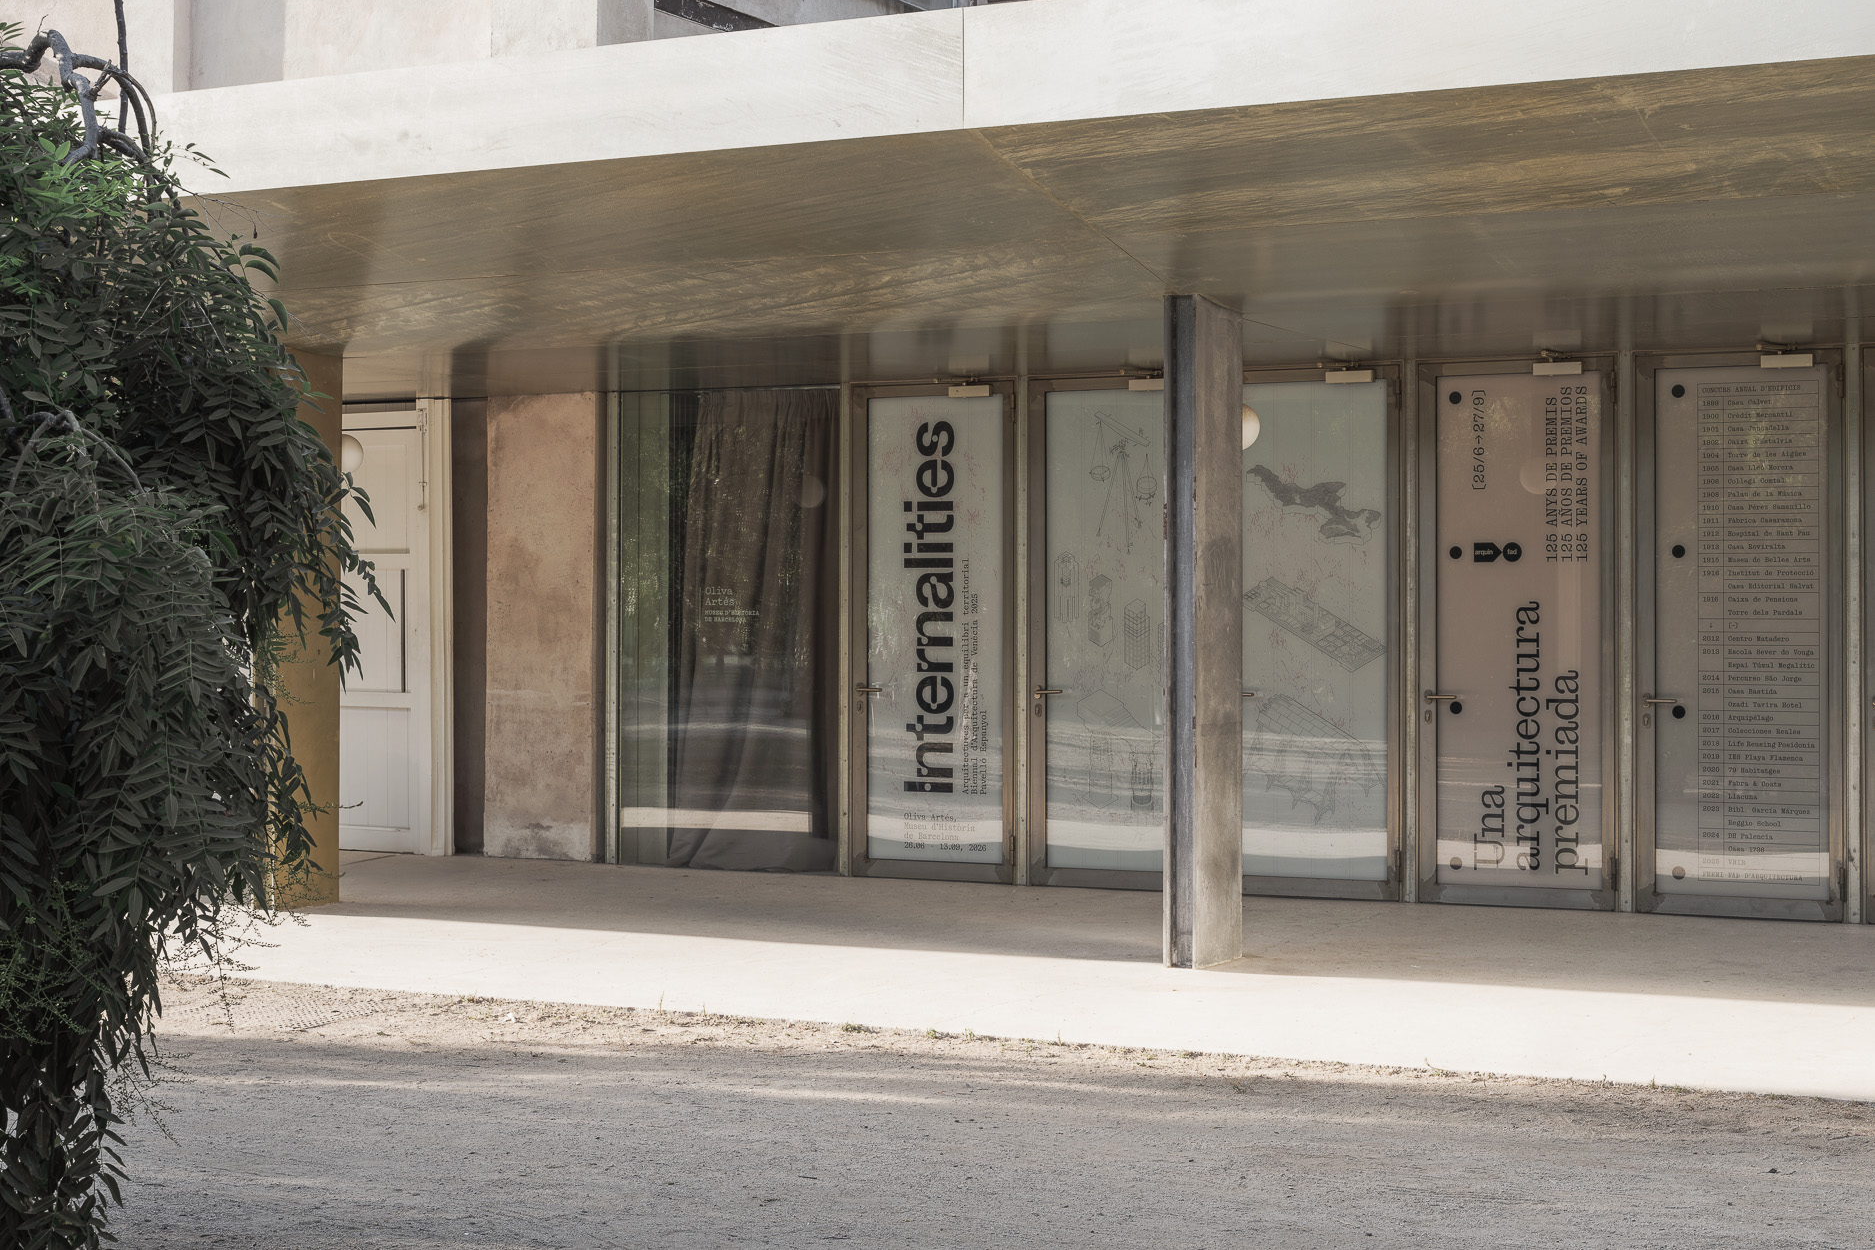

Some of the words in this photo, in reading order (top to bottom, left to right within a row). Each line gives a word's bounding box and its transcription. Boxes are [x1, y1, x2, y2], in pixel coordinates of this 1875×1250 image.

[1546, 396, 1558, 456] PREMIS
[1560, 386, 1573, 457] PREMIOS
[1576, 385, 1588, 446] AWARDS
[1546, 462, 1558, 482] DE
[1560, 462, 1573, 482] DE
[1576, 450, 1588, 472] OF
[1546, 488, 1558, 528] ANYS
[1558, 488, 1573, 528] AÑOS
[1576, 477, 1588, 528] YEARS
[1546, 533, 1558, 563] 125
[1560, 533, 1573, 563] 125
[1576, 533, 1588, 563] 125
[1728, 530, 1760, 538] Hospital
[705, 586, 733, 595] Oliva
[705, 597, 735, 605] Artés
[904, 420, 955, 793] Internalities
[962, 622, 971, 670] equilibri
[964, 675, 969, 687] un
[971, 662, 978, 673] de
[971, 679, 979, 751] d'Arquitectura
[980, 710, 988, 752] Espanyol
[1728, 714, 1773, 722] Arquipélago
[1507, 601, 1548, 871] arquitectura
[962, 726, 970, 794] Arquitectures
[1546, 670, 1588, 875] premiada
[904, 822, 926, 830] Museu
[931, 814, 957, 822] Artés,
[1474, 785, 1506, 870] Una
